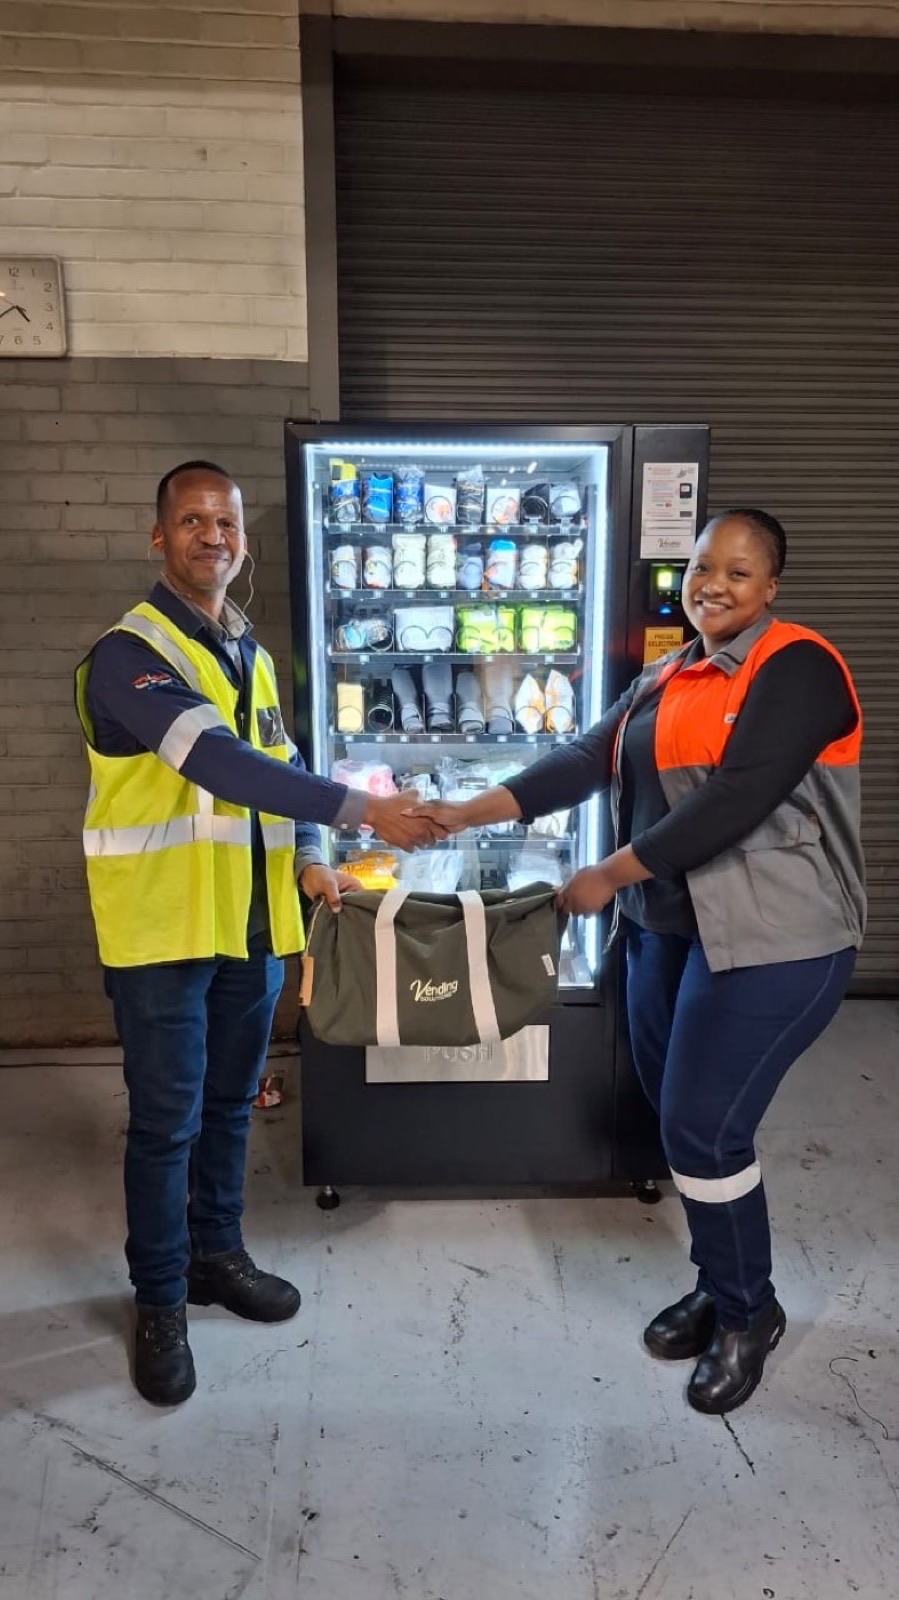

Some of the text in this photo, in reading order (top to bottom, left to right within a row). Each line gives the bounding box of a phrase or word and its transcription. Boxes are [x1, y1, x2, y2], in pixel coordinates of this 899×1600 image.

[8, 267, 19, 277] 12
[43, 282, 52, 292] 2
[44, 303, 53, 311] 3
[46, 321, 53, 330] 4
[14, 335, 23, 345] 6
[33, 335, 41, 345] 5
[410, 978, 458, 1001] Vending
[424, 1043, 494, 1063] PUSH
